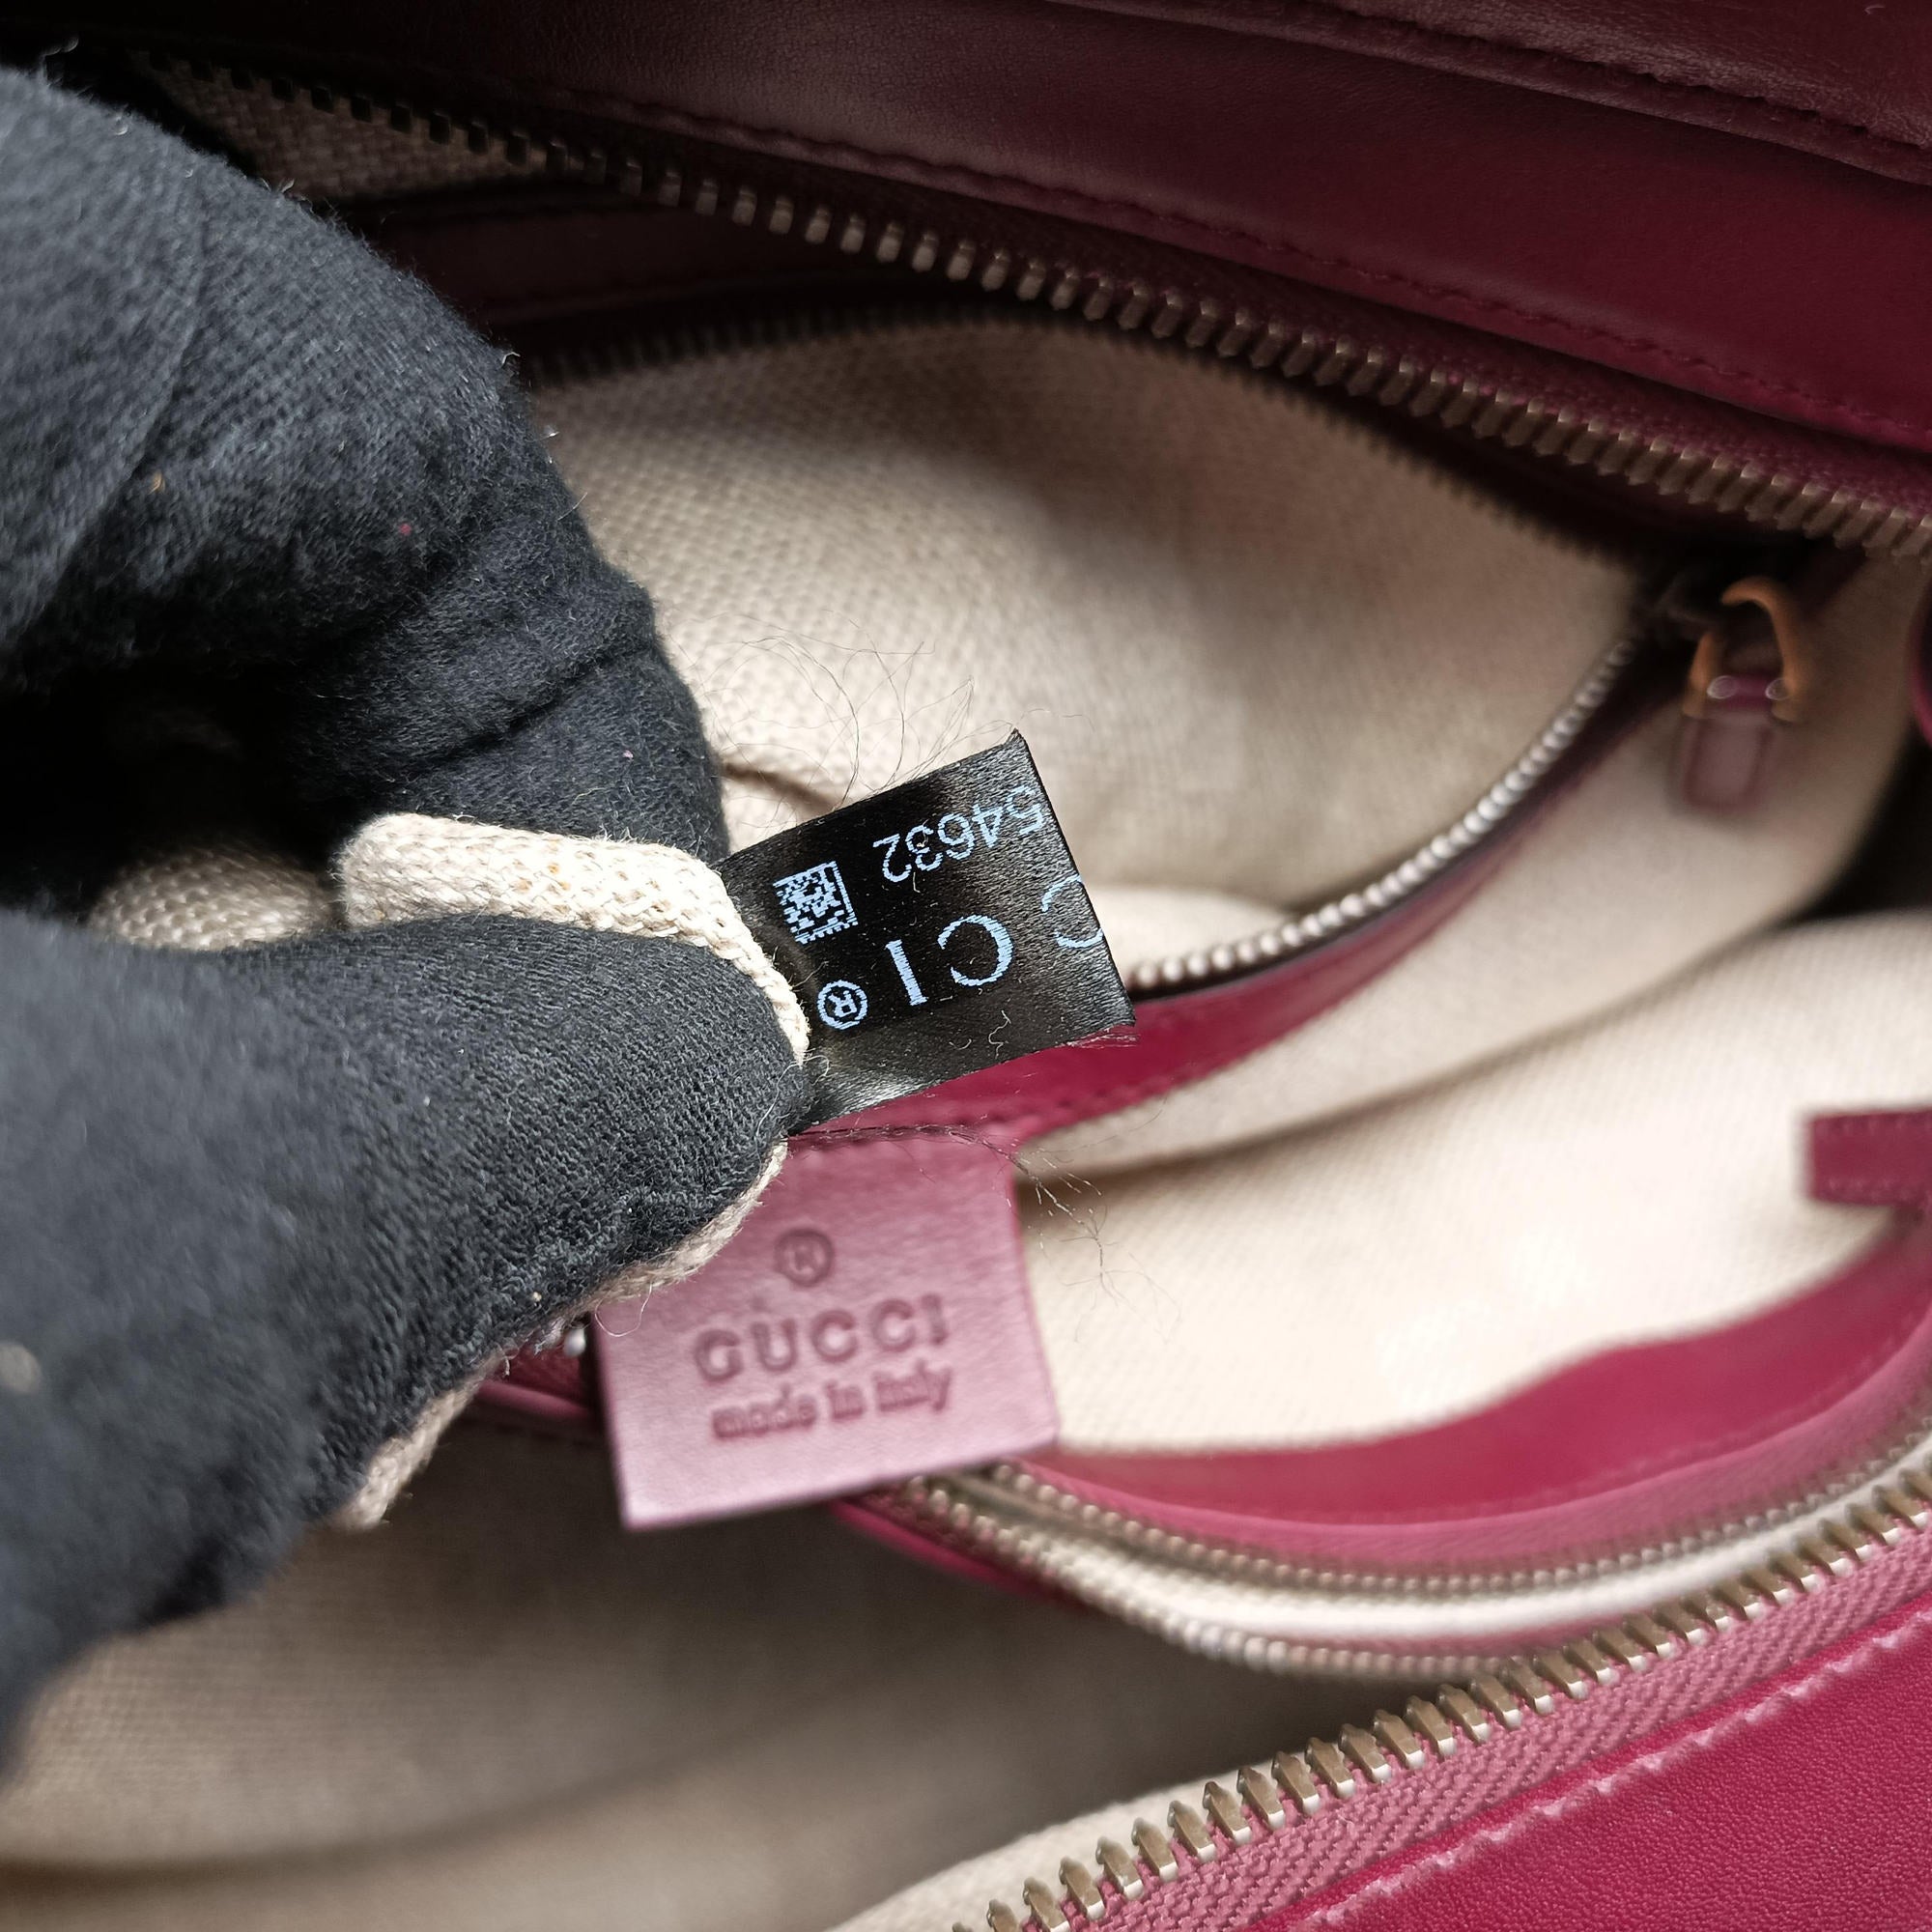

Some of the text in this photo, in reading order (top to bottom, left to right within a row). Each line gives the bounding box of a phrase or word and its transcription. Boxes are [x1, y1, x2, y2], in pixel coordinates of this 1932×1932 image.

[872, 785, 1046, 883] 54632
[694, 1293, 948, 1384] GUCCI
[712, 1381, 817, 1438] made
[825, 1379, 865, 1422] in
